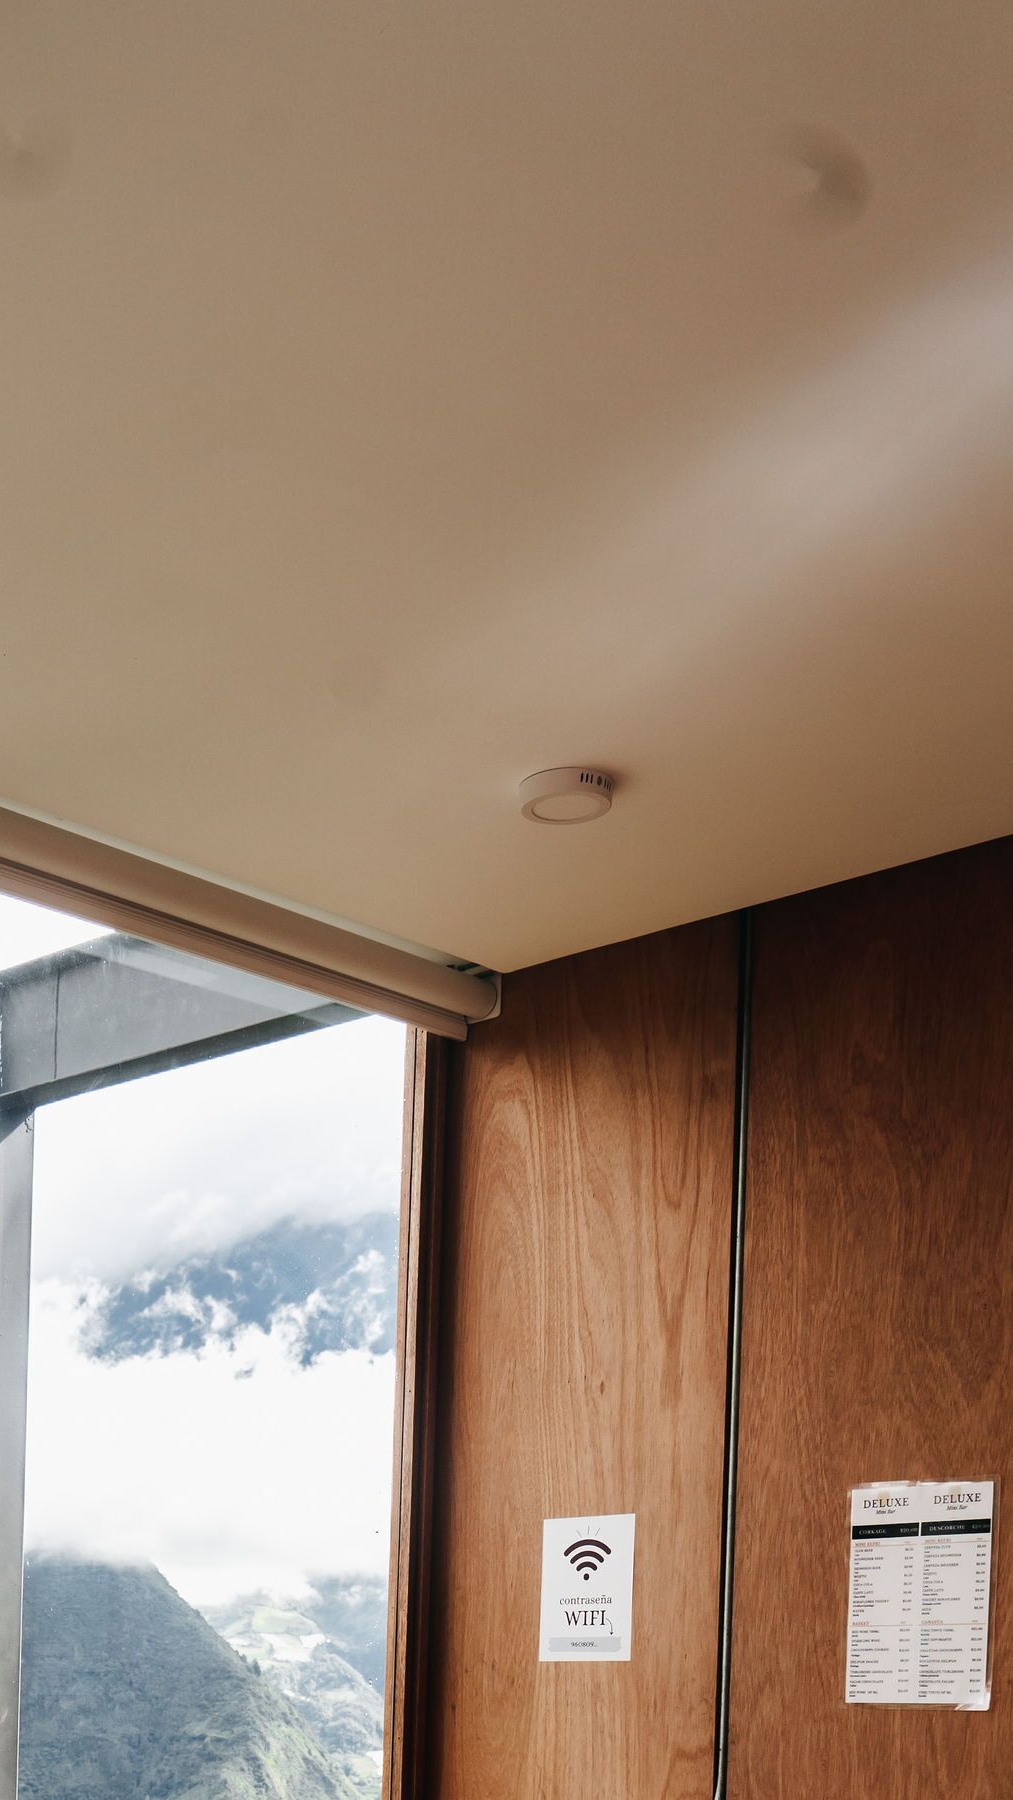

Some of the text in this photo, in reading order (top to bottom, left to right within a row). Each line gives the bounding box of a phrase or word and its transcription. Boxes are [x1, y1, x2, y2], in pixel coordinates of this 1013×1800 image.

[863, 1498, 909, 1508] DELUXE
[933, 1493, 981, 1504] DELUXE
[559, 1595, 612, 1605] contraseña
[564, 1610, 606, 1626] WIFI
